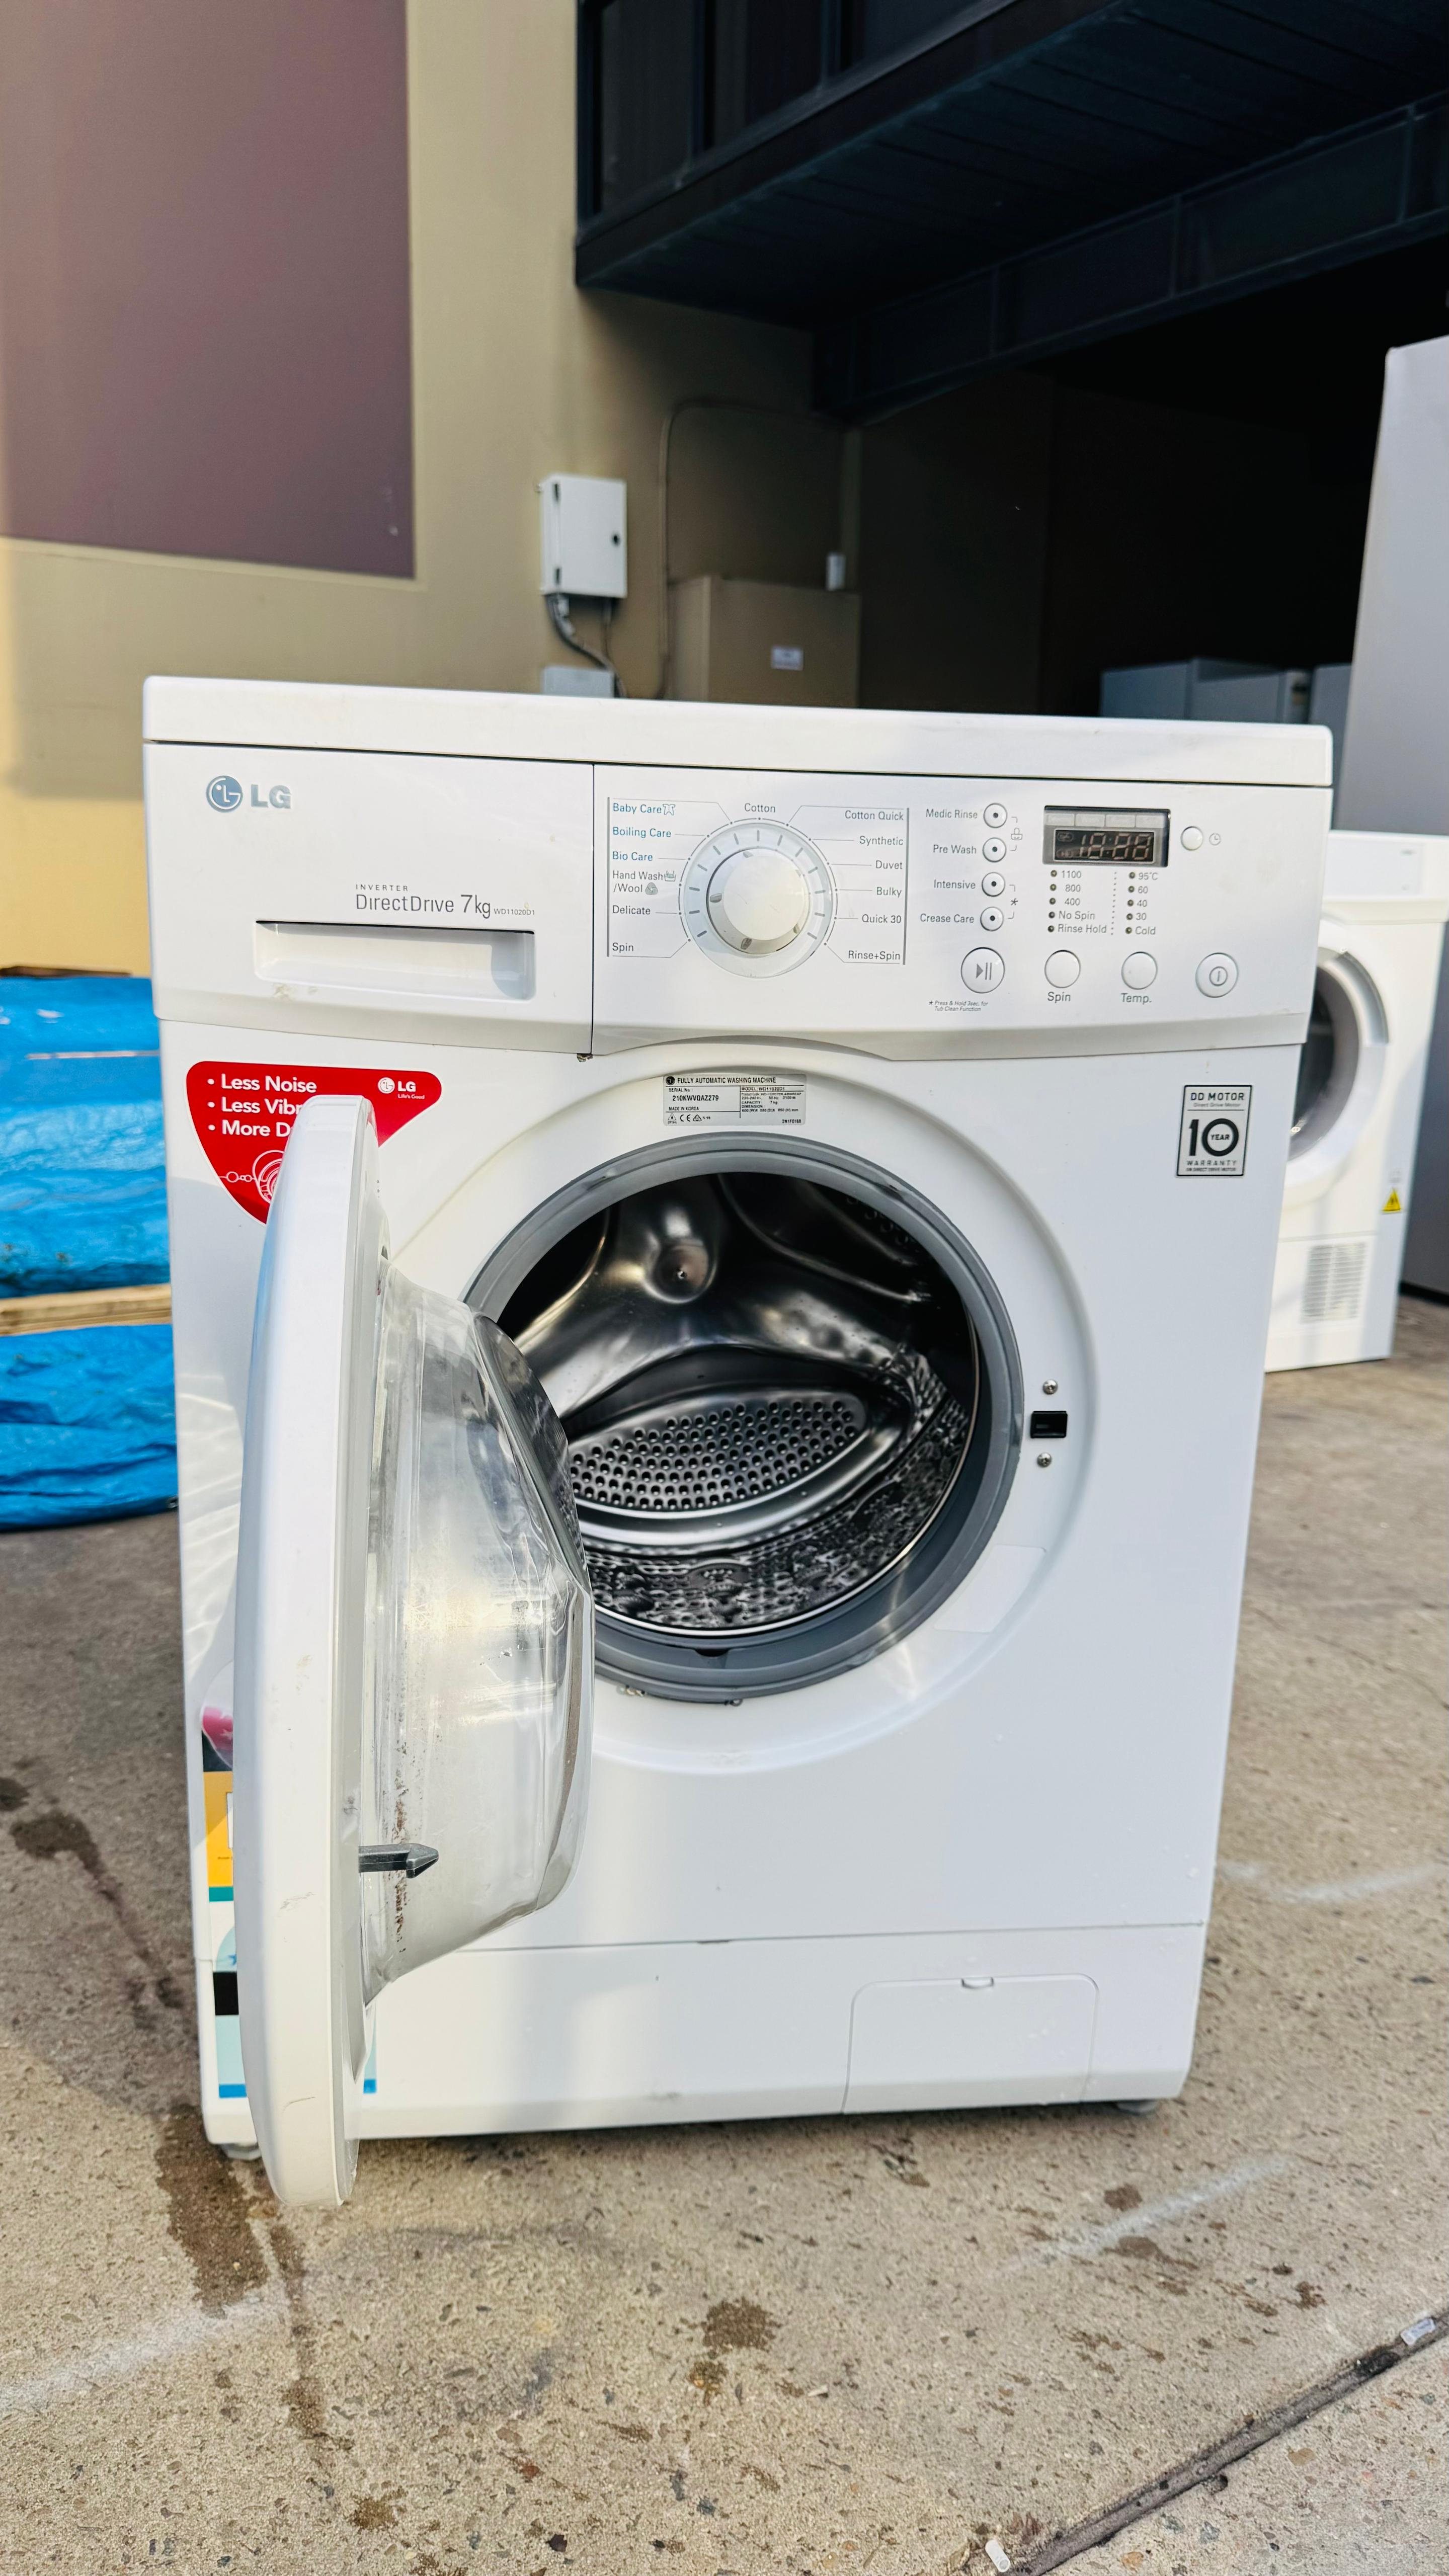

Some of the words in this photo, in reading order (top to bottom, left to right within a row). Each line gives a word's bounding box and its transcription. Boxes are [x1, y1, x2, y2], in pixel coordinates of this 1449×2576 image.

[251, 784, 292, 810] LG
[612, 802, 637, 815] Baby
[639, 804, 662, 814] Care
[744, 802, 776, 813] Cotton
[845, 810, 875, 820] Cotton
[877, 811, 904, 821] Quick
[926, 809, 952, 818] Medic
[954, 809, 978, 819] Rinse
[612, 827, 647, 838] Boiling
[648, 828, 672, 838] Care
[859, 835, 904, 846] Synthetic
[933, 844, 948, 853] Pre
[951, 845, 977, 854] Wash
[612, 851, 627, 861] Bio
[630, 852, 653, 861] Care
[875, 860, 903, 870] Duvet
[612, 870, 636, 880] Hand
[637, 871, 664, 881] Wash
[1061, 870, 1082, 878] 1100
[613, 883, 643, 894] /Wool
[933, 879, 976, 889] Intensive
[1065, 884, 1081, 893] 800
[876, 887, 903, 898] Bulky
[1137, 886, 1149, 894] 60
[1064, 898, 1081, 906] 400
[1136, 899, 1148, 907] 40
[493, 908, 535, 916] WD11020D1
[612, 905, 651, 915] Delicate
[1059, 910, 1072, 920] No
[1074, 911, 1095, 921] Spin
[861, 914, 888, 925] Quick
[891, 914, 902, 924] 30
[920, 913, 951, 923] Crease
[953, 914, 975, 923] Care
[1136, 912, 1147, 921] 30
[1057, 924, 1082, 933] Rinse
[1085, 924, 1107, 933] Hold
[1135, 926, 1156, 935] Cold
[612, 942, 634, 953] Spin
[848, 950, 901, 961] Rinse+Spin
[1047, 991, 1071, 1003] Spin
[1120, 993, 1153, 1004] Temp.
[221, 1073, 261, 1091] Less
[265, 1075, 317, 1093] Noise
[397, 1081, 417, 1092] LG
[1190, 1092, 1204, 1101] DD
[1208, 1092, 1245, 1101] MOTOR
[221, 1096, 261, 1113] Less
[264, 1098, 303, 1115] Vibr
[221, 1119, 271, 1137] More
[1188, 1118, 1240, 1157] 10
